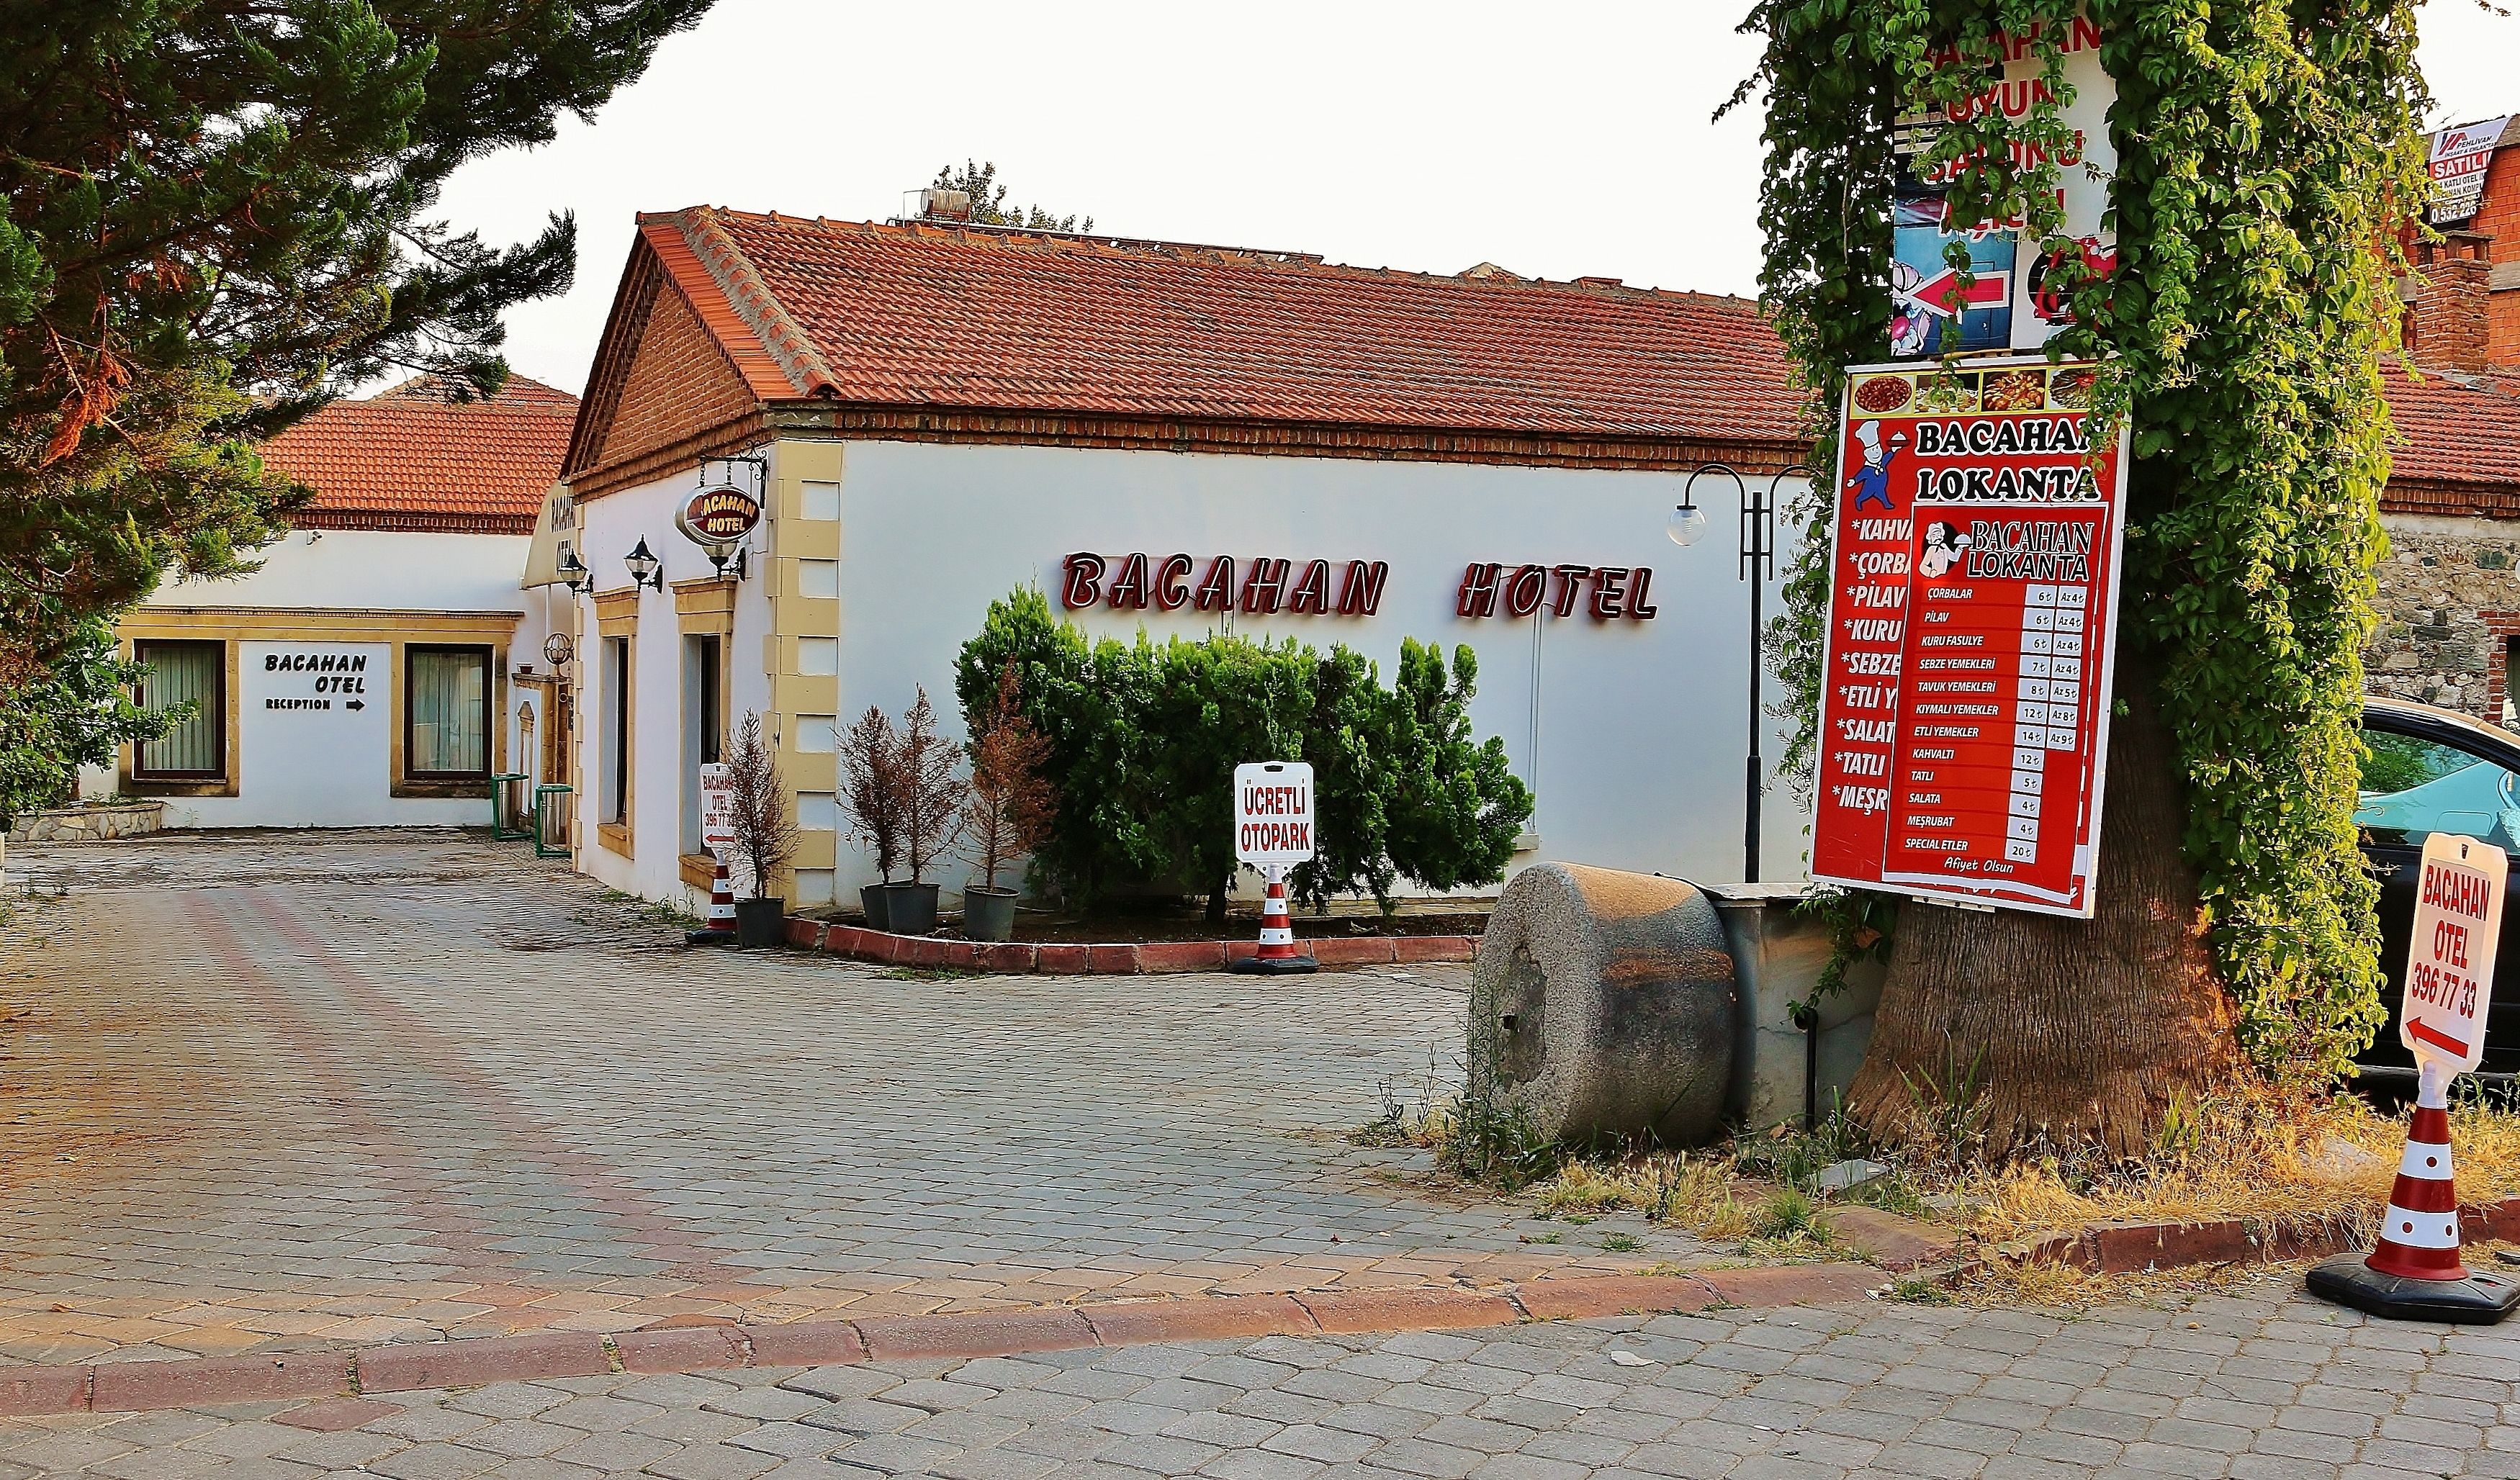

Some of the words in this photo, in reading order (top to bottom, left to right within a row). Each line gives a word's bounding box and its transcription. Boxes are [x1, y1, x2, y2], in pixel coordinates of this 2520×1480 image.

[2434, 150, 2493, 179] SATILI
[1915, 466, 2101, 502] LOKANTA
[701, 495, 756, 518] ACAHAN
[708, 518, 745, 532] HOTEL
[1971, 520, 2095, 554] BACAHAN
[1967, 551, 2089, 582] LOKANTA
[1061, 551, 1389, 616] BACAHAN
[1456, 562, 1658, 620] HOTEL
[1927, 587, 1973, 600] ÇORBALAR
[1925, 610, 1949, 622] PİLAV
[1922, 636, 1945, 646] KURU
[1946, 636, 1984, 646] FASULYE
[265, 654, 367, 672] BACAHAN
[1920, 659, 1946, 669] SEBZE
[1947, 658, 1996, 669] YEMEKLERİ
[315, 676, 365, 693] OTEL
[1918, 682, 1946, 692] TAVUK
[1947, 680, 1997, 692] YEMEKLERİ
[266, 699, 330, 710] RECEPTION
[1916, 704, 1950, 714] KIYMALI
[1953, 705, 1999, 716] YEMEKLER
[1914, 725, 1932, 736] ETLİ
[1934, 726, 1979, 737] YEMEKLER
[1912, 749, 1954, 759] KAHVALTI
[1911, 771, 1934, 781] TATLI
[712, 795, 727, 811] OTEL
[1244, 778, 1305, 816] ÜCRETLİ
[1909, 793, 1940, 804] SALATA
[705, 813, 716, 827] 396
[1907, 816, 1955, 828] MEŞRUBAT
[1241, 823, 1310, 852] OTOPARK
[1905, 838, 1940, 849] SPECIAL
[1941, 840, 1968, 851] ETLER
[1944, 857, 1978, 872] Afiyet
[1984, 860, 2013, 873] Olsun
[2423, 865, 2490, 921] BACAHAN
[2434, 919, 2468, 970] OTEL
[2412, 962, 2438, 1005] 396
[2439, 972, 2459, 1010] 77
[2460, 978, 2477, 1020] 33
